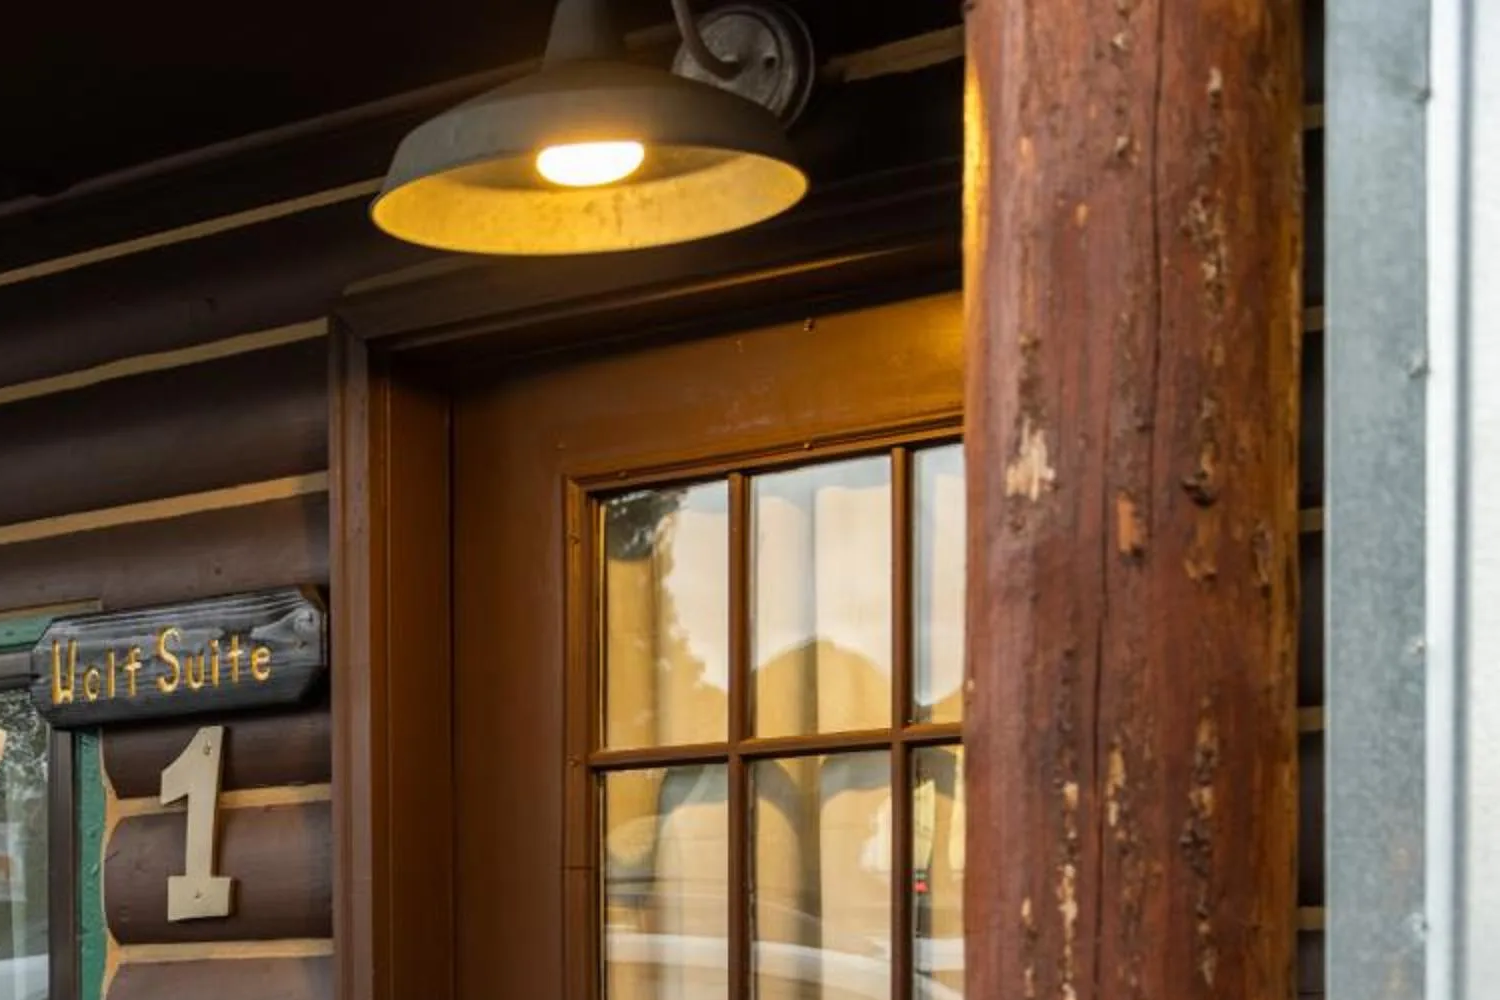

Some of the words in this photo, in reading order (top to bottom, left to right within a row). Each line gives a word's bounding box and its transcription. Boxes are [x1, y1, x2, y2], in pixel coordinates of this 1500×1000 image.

[51, 638, 142, 706] Wolf
[157, 626, 273, 693] Suite
[160, 725, 232, 922] 1
